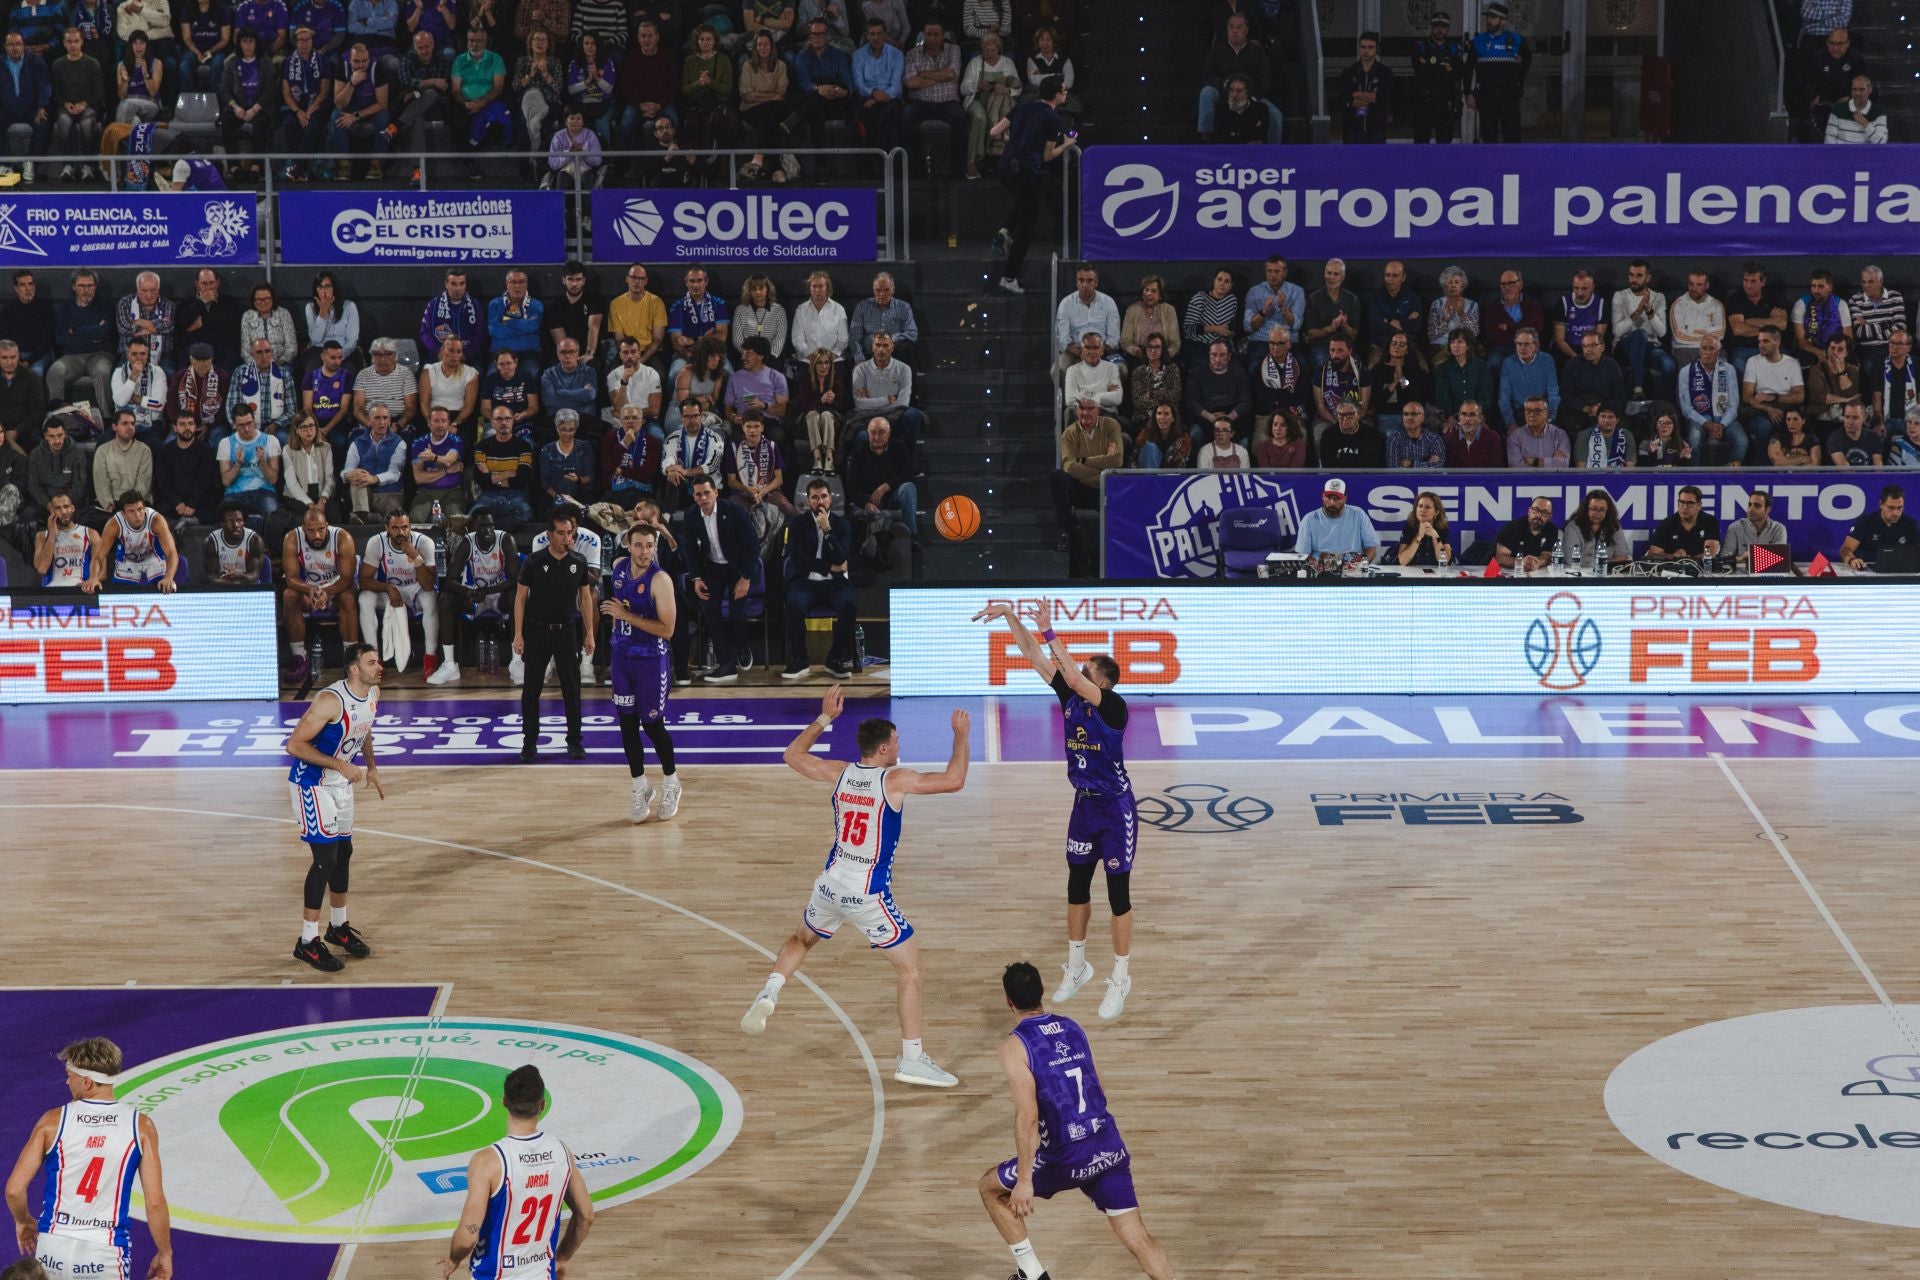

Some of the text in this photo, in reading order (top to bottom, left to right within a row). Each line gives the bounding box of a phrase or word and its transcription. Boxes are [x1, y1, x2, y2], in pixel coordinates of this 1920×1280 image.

[1195, 163, 1296, 190] súper
[26, 208, 168, 222] FRIO PALENCIA, S.L.
[375, 195, 512, 221] Áridos y Excavaciones
[1196, 171, 1920, 240] agropal palencia
[672, 195, 850, 241] soltec
[28, 224, 168, 237] FRIO Y CLIMATIZACION
[375, 224, 399, 238] EL
[70, 244, 80, 252] NO
[140, 240, 150, 249] DE
[375, 247, 457, 260] Hormigones
[460, 250, 468, 261] y
[676, 245, 837, 257] Suministros de Soldadura
[1630, 595, 1819, 620] PRIMERA
[620, 621, 632, 636] 13
[1629, 629, 1820, 682] FEB
[1310, 792, 1570, 802] PRIMERA
[1314, 804, 1585, 826] FEB
[841, 811, 869, 847] 15
[181, 1052, 273, 1086] sobre
[284, 1040, 320, 1056] el
[330, 1032, 481, 1052] parqué,
[497, 1036, 560, 1052] con
[557, 1048, 609, 1067] pé.
[1065, 1066, 1087, 1114] 7
[77, 1114, 119, 1125] Kosner
[85, 1135, 107, 1149] ARIS
[518, 1150, 553, 1164] Kosner
[1070, 1148, 1127, 1179] LEBANZA
[76, 1156, 105, 1204] 4
[525, 1170, 550, 1189] JORDÁ
[71, 1215, 115, 1229] Inurban
[511, 1194, 554, 1246] 21
[72, 1262, 105, 1274] ante
